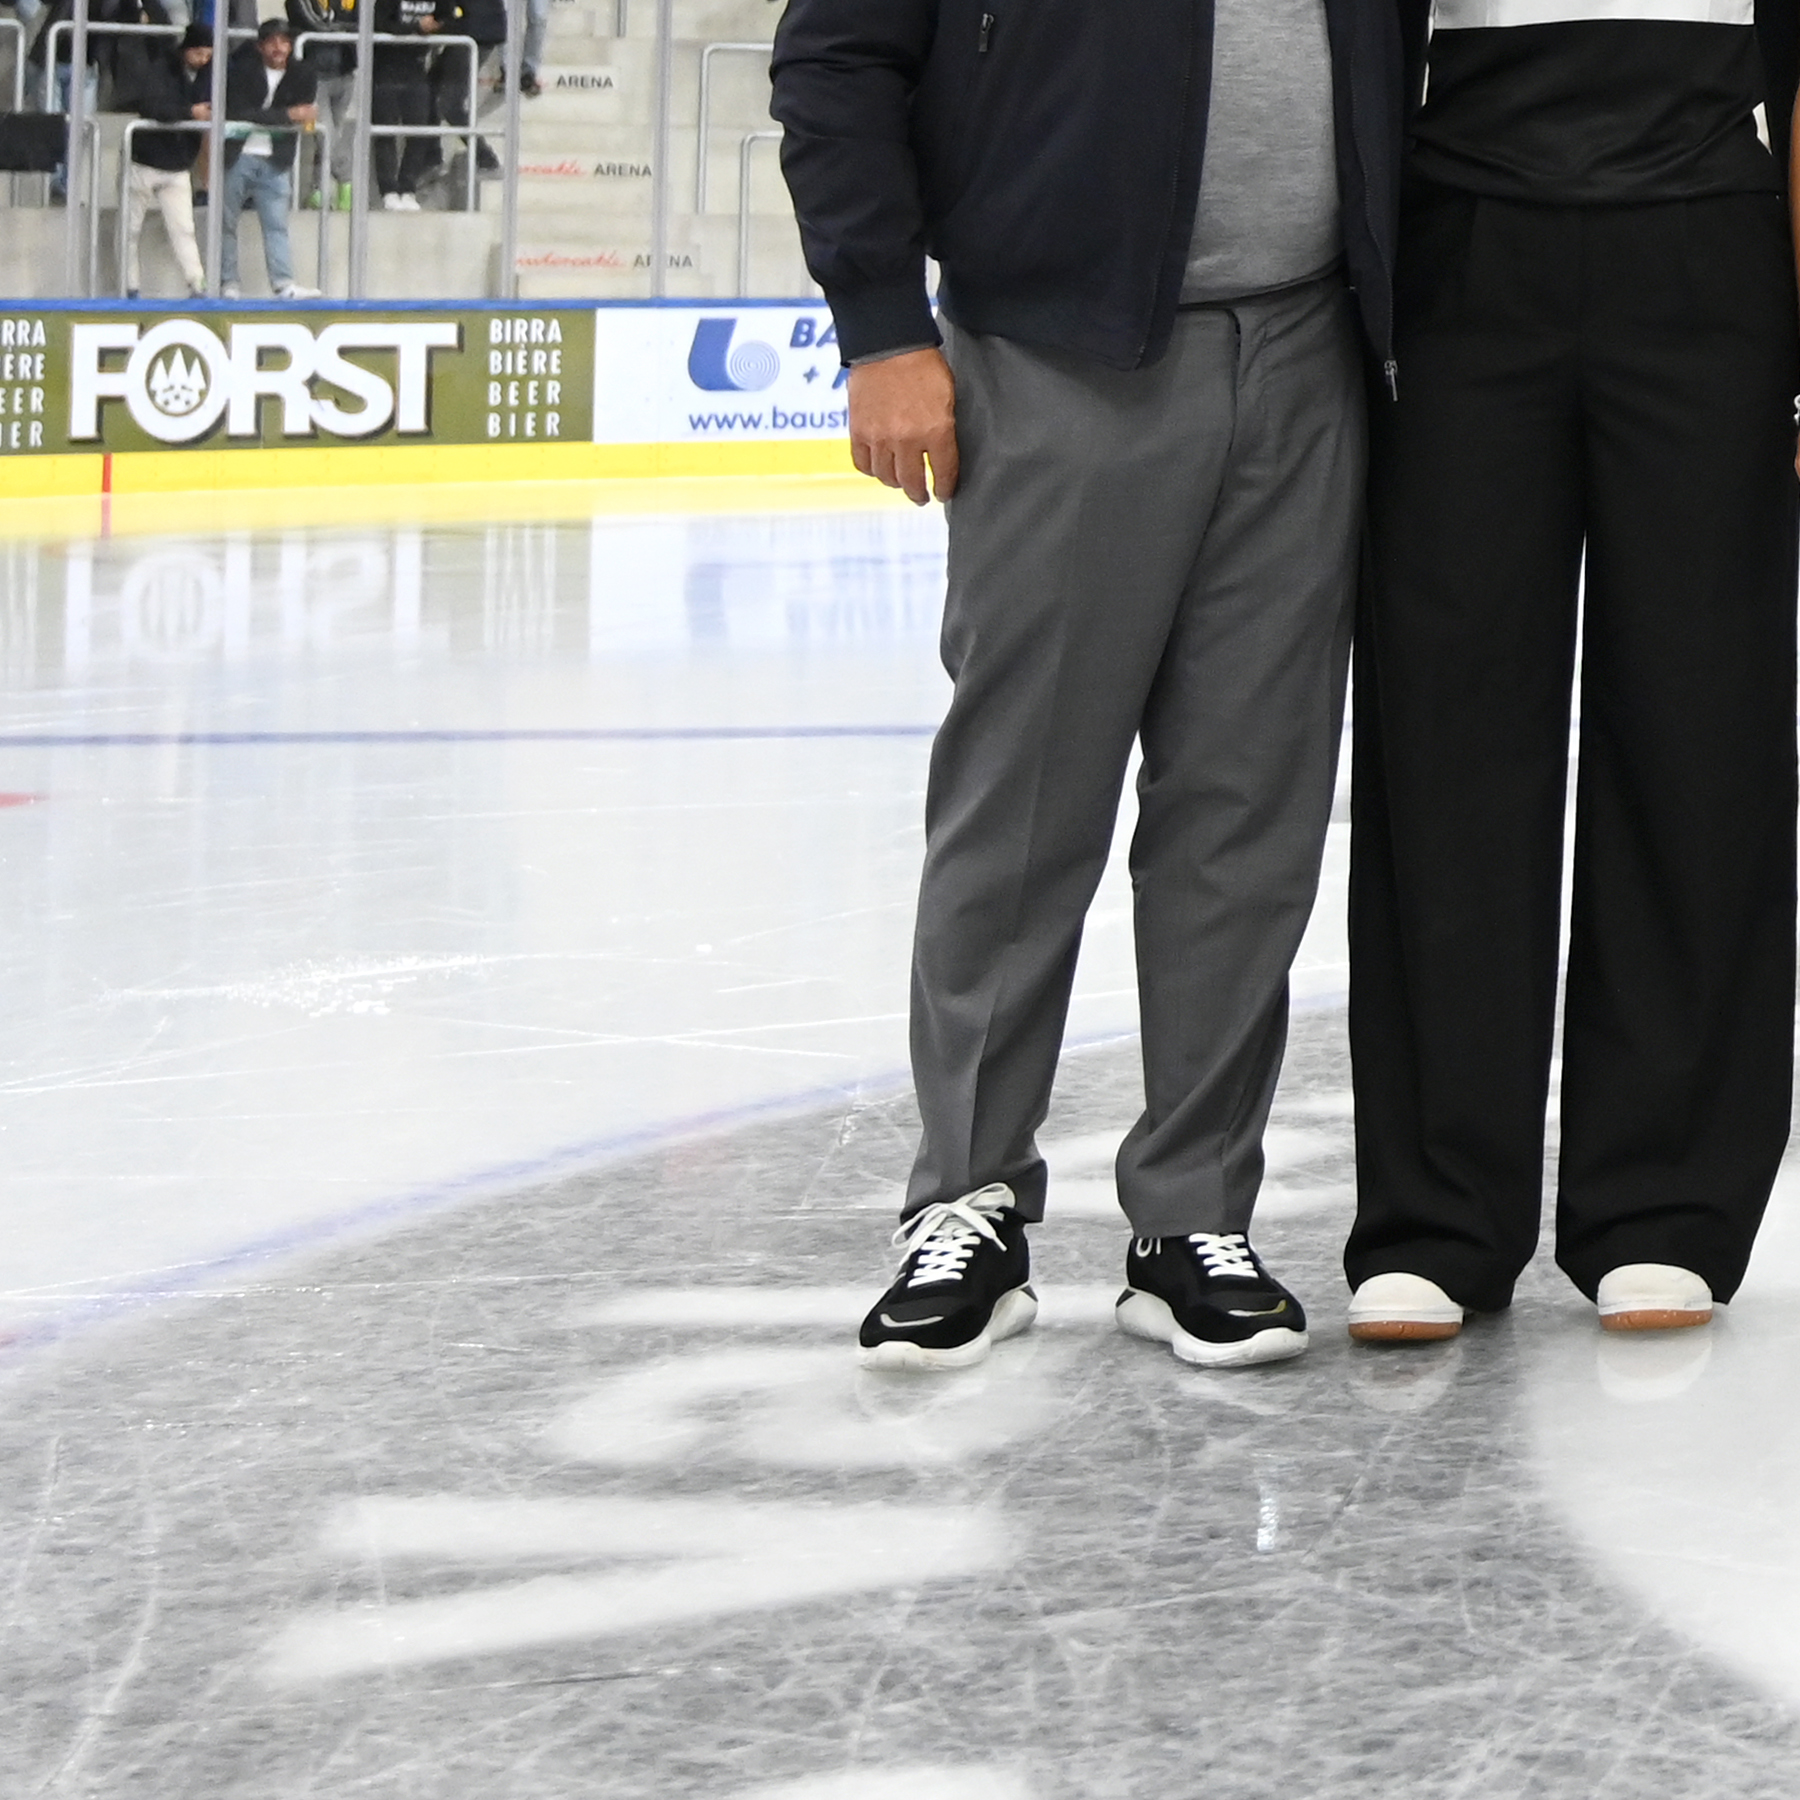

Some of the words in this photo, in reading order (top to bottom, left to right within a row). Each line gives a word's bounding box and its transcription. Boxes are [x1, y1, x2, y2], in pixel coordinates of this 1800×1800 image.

[556, 74, 614, 89] ARENA
[593, 162, 653, 178] ARENA
[1, 318, 46, 347] RRA
[489, 317, 563, 344] BIRRA
[488, 343, 562, 376] BIÈRE
[69, 318, 461, 443] FORST
[487, 380, 561, 407] BEER
[486, 411, 560, 438] BIER
[688, 405, 848, 431] www.baust
